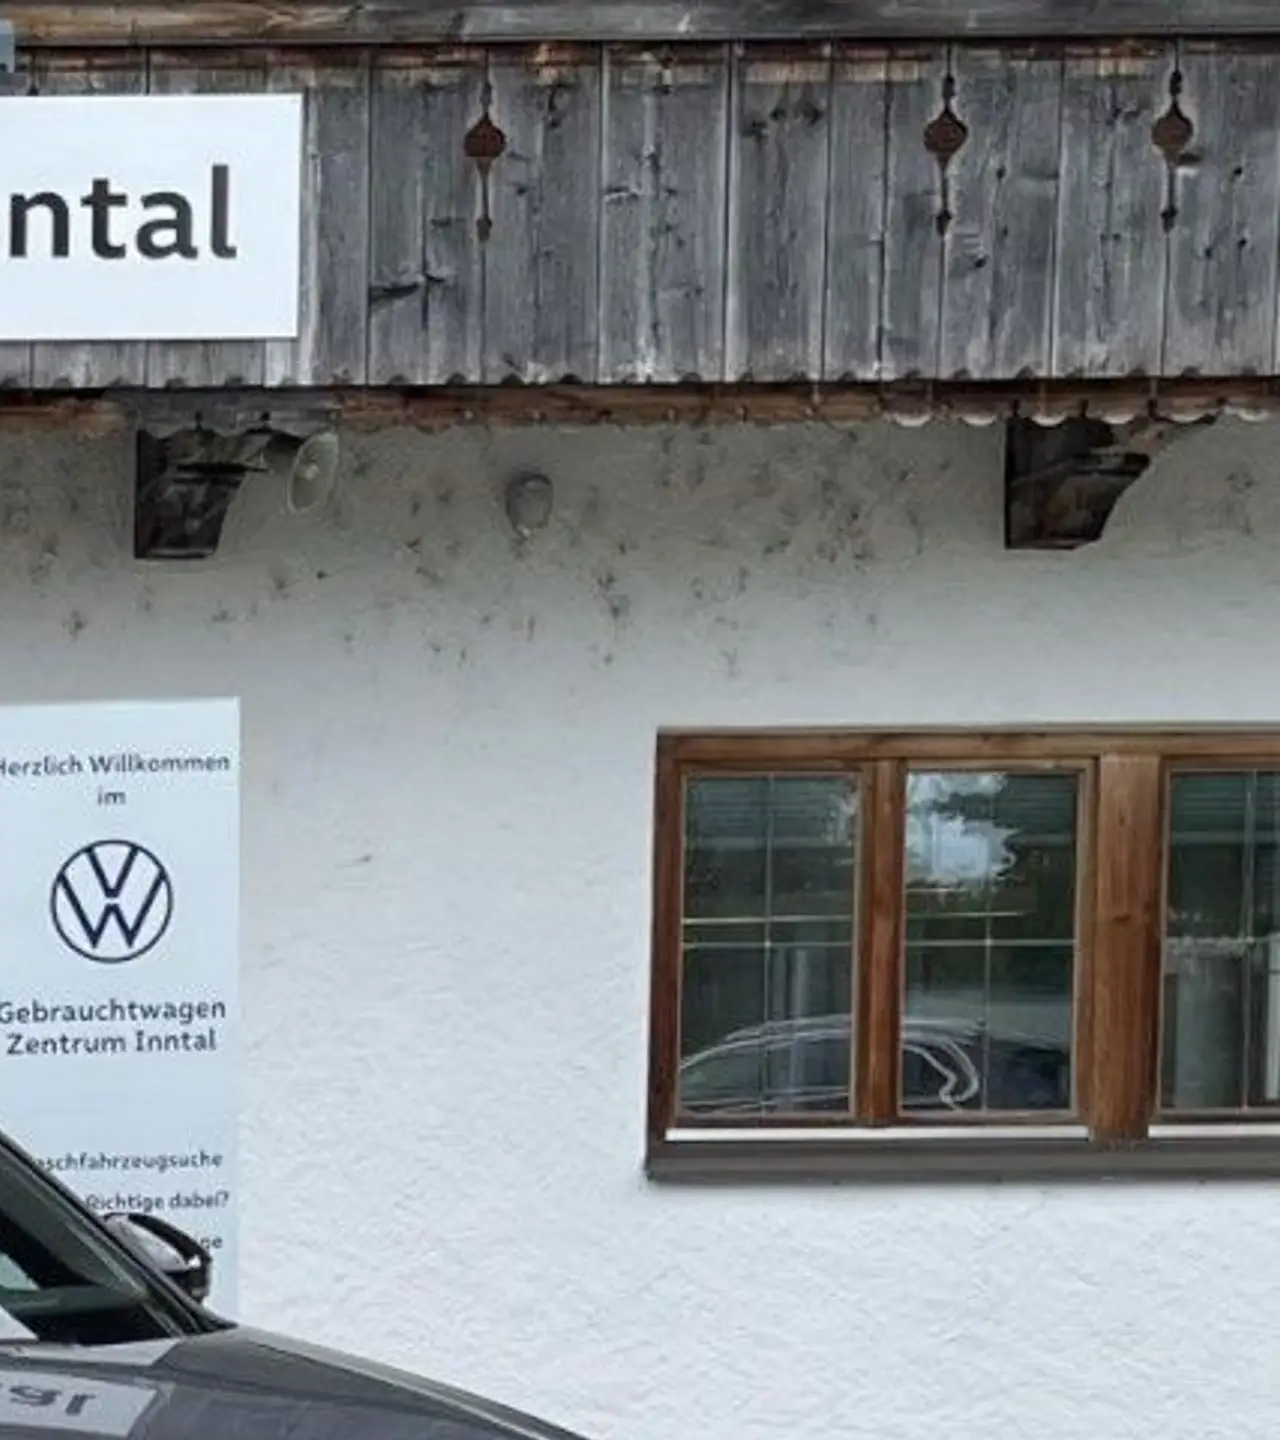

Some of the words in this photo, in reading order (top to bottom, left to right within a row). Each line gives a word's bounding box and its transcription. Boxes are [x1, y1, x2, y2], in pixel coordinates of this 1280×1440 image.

[88, 752, 230, 774] Willkommen
[97, 788, 126, 806] im
[6, 1031, 126, 1056] Zentrum
[135, 1027, 217, 1052] Inntal
[38, 1151, 223, 1174] nschfahrzeugsuche
[168, 1191, 230, 1210] dabei?
